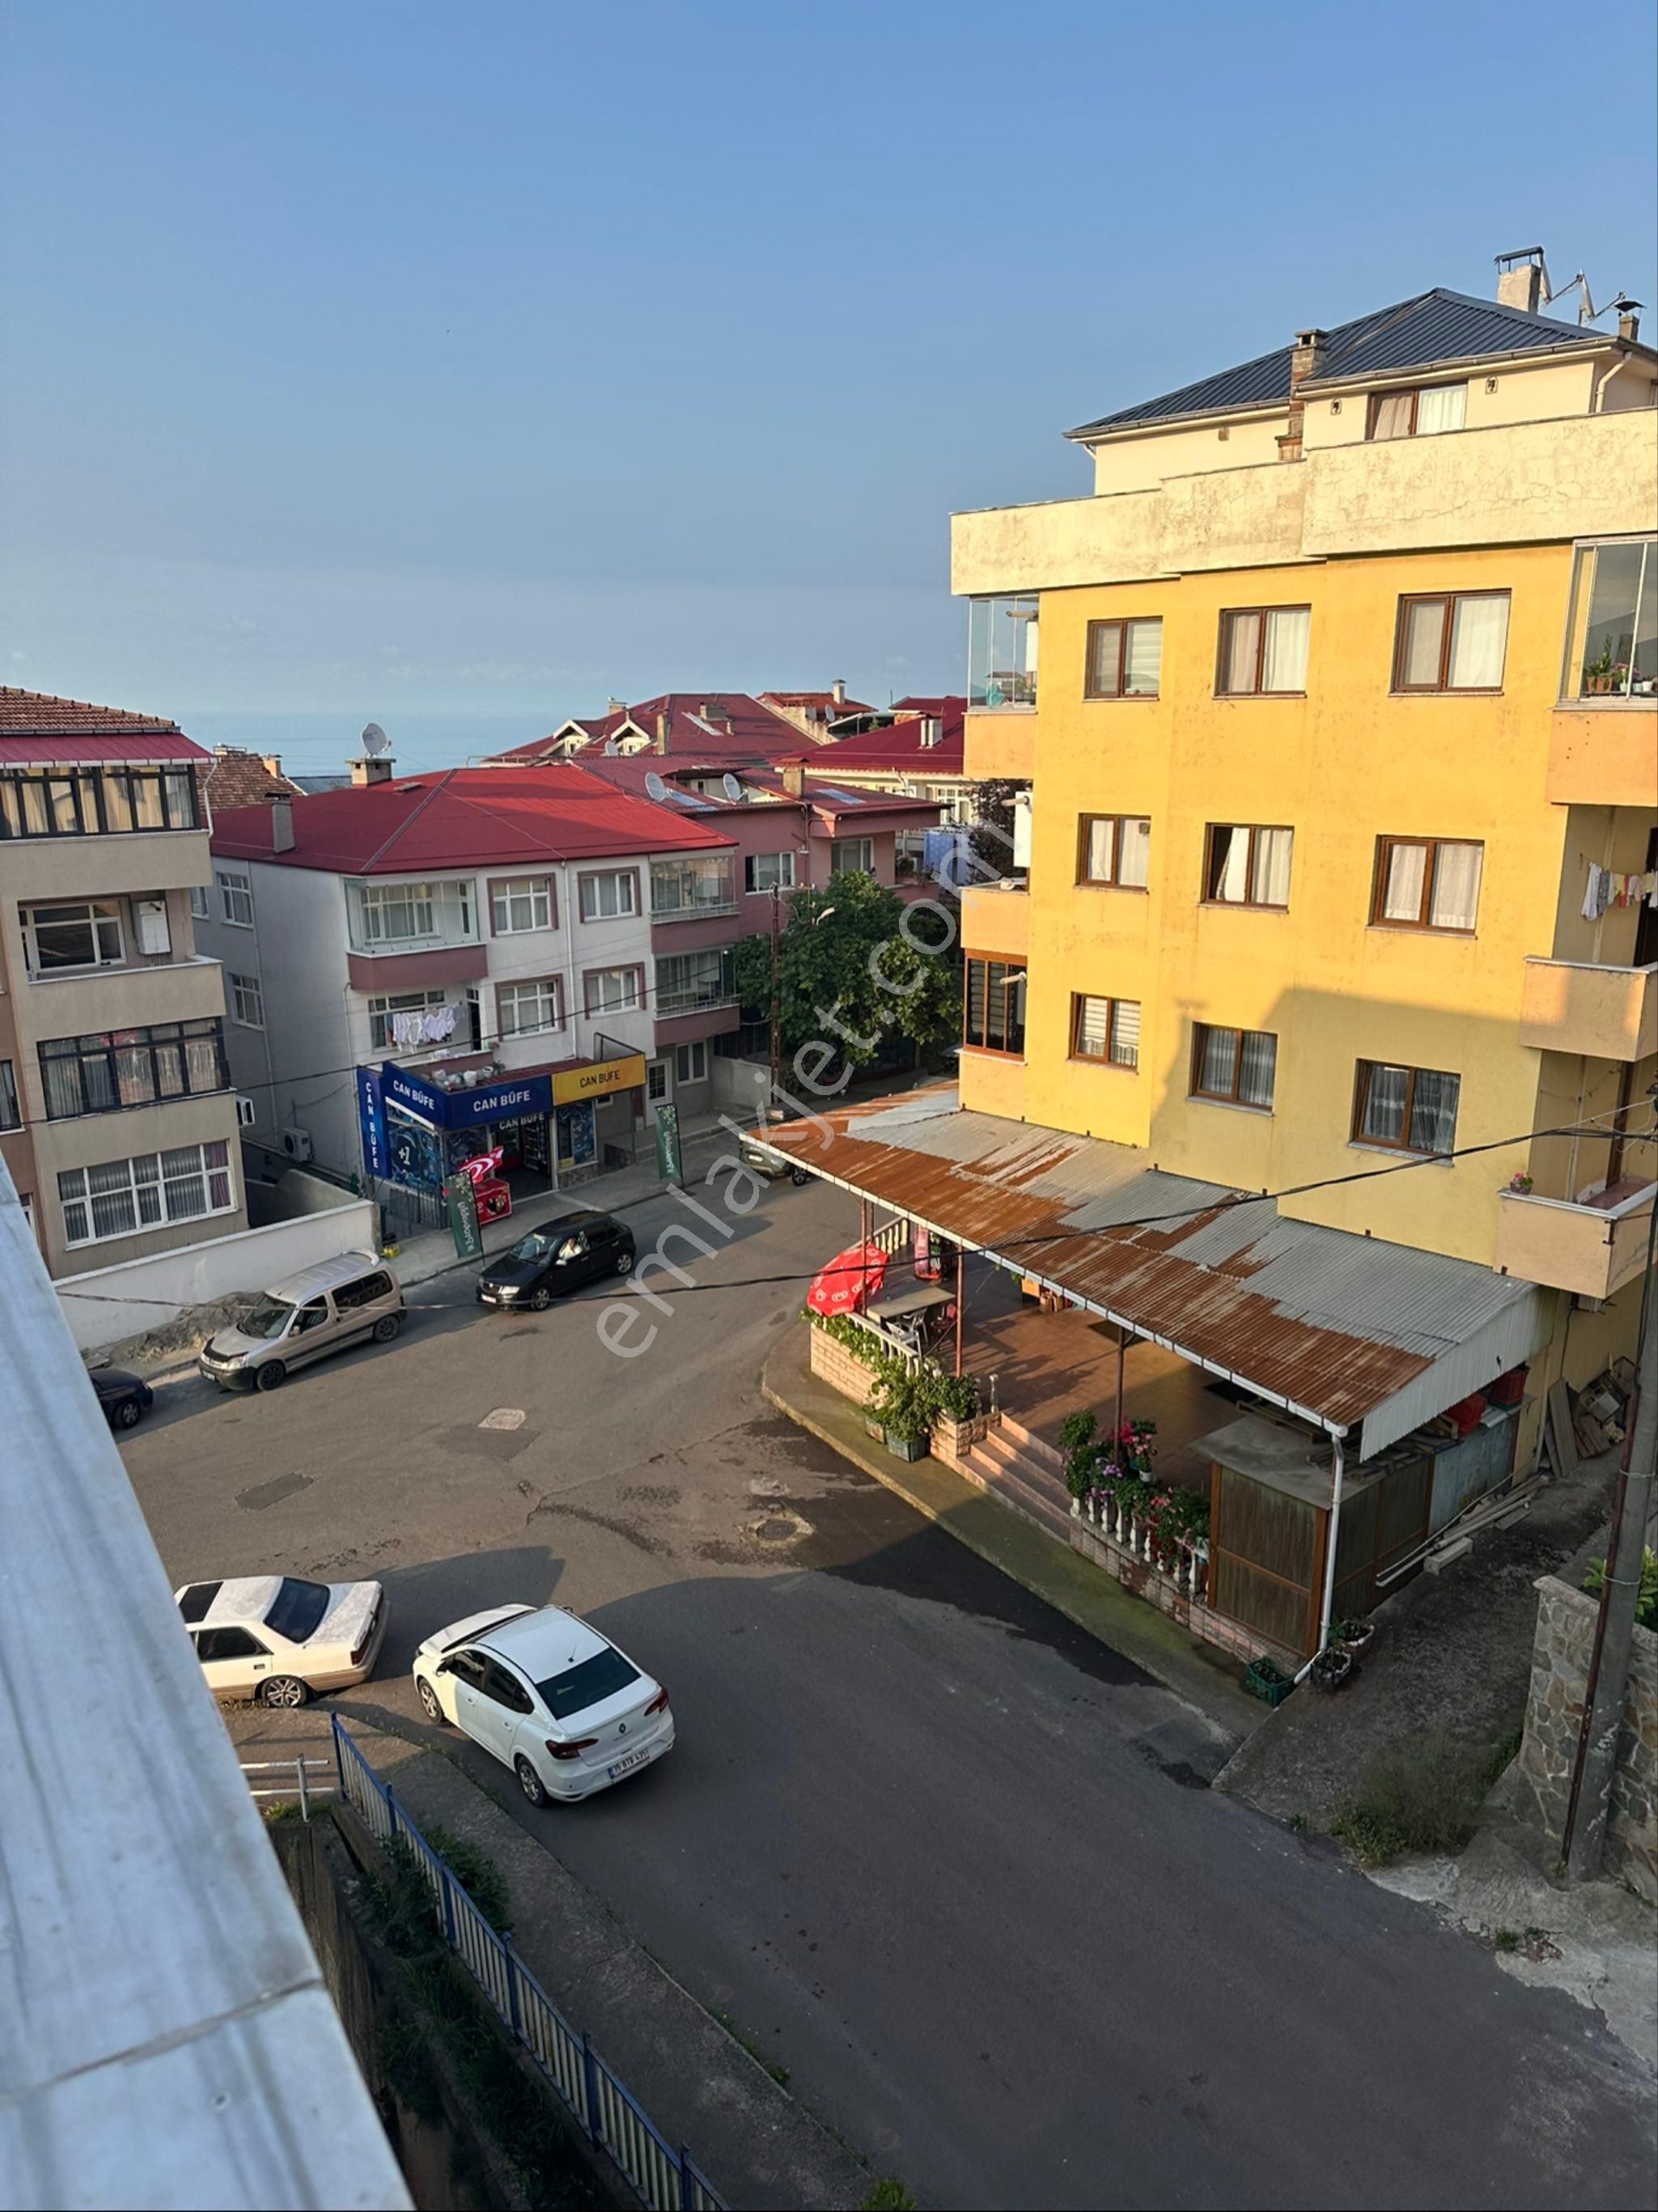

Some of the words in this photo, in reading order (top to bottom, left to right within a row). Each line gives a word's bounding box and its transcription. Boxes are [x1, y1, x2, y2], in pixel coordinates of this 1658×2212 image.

[393, 1080, 410, 1098] CAN
[579, 1075, 597, 1088] CAN
[366, 1082, 374, 1115] CAN
[473, 1097, 498, 1112] CAN
[498, 1118, 519, 1130] CAN
